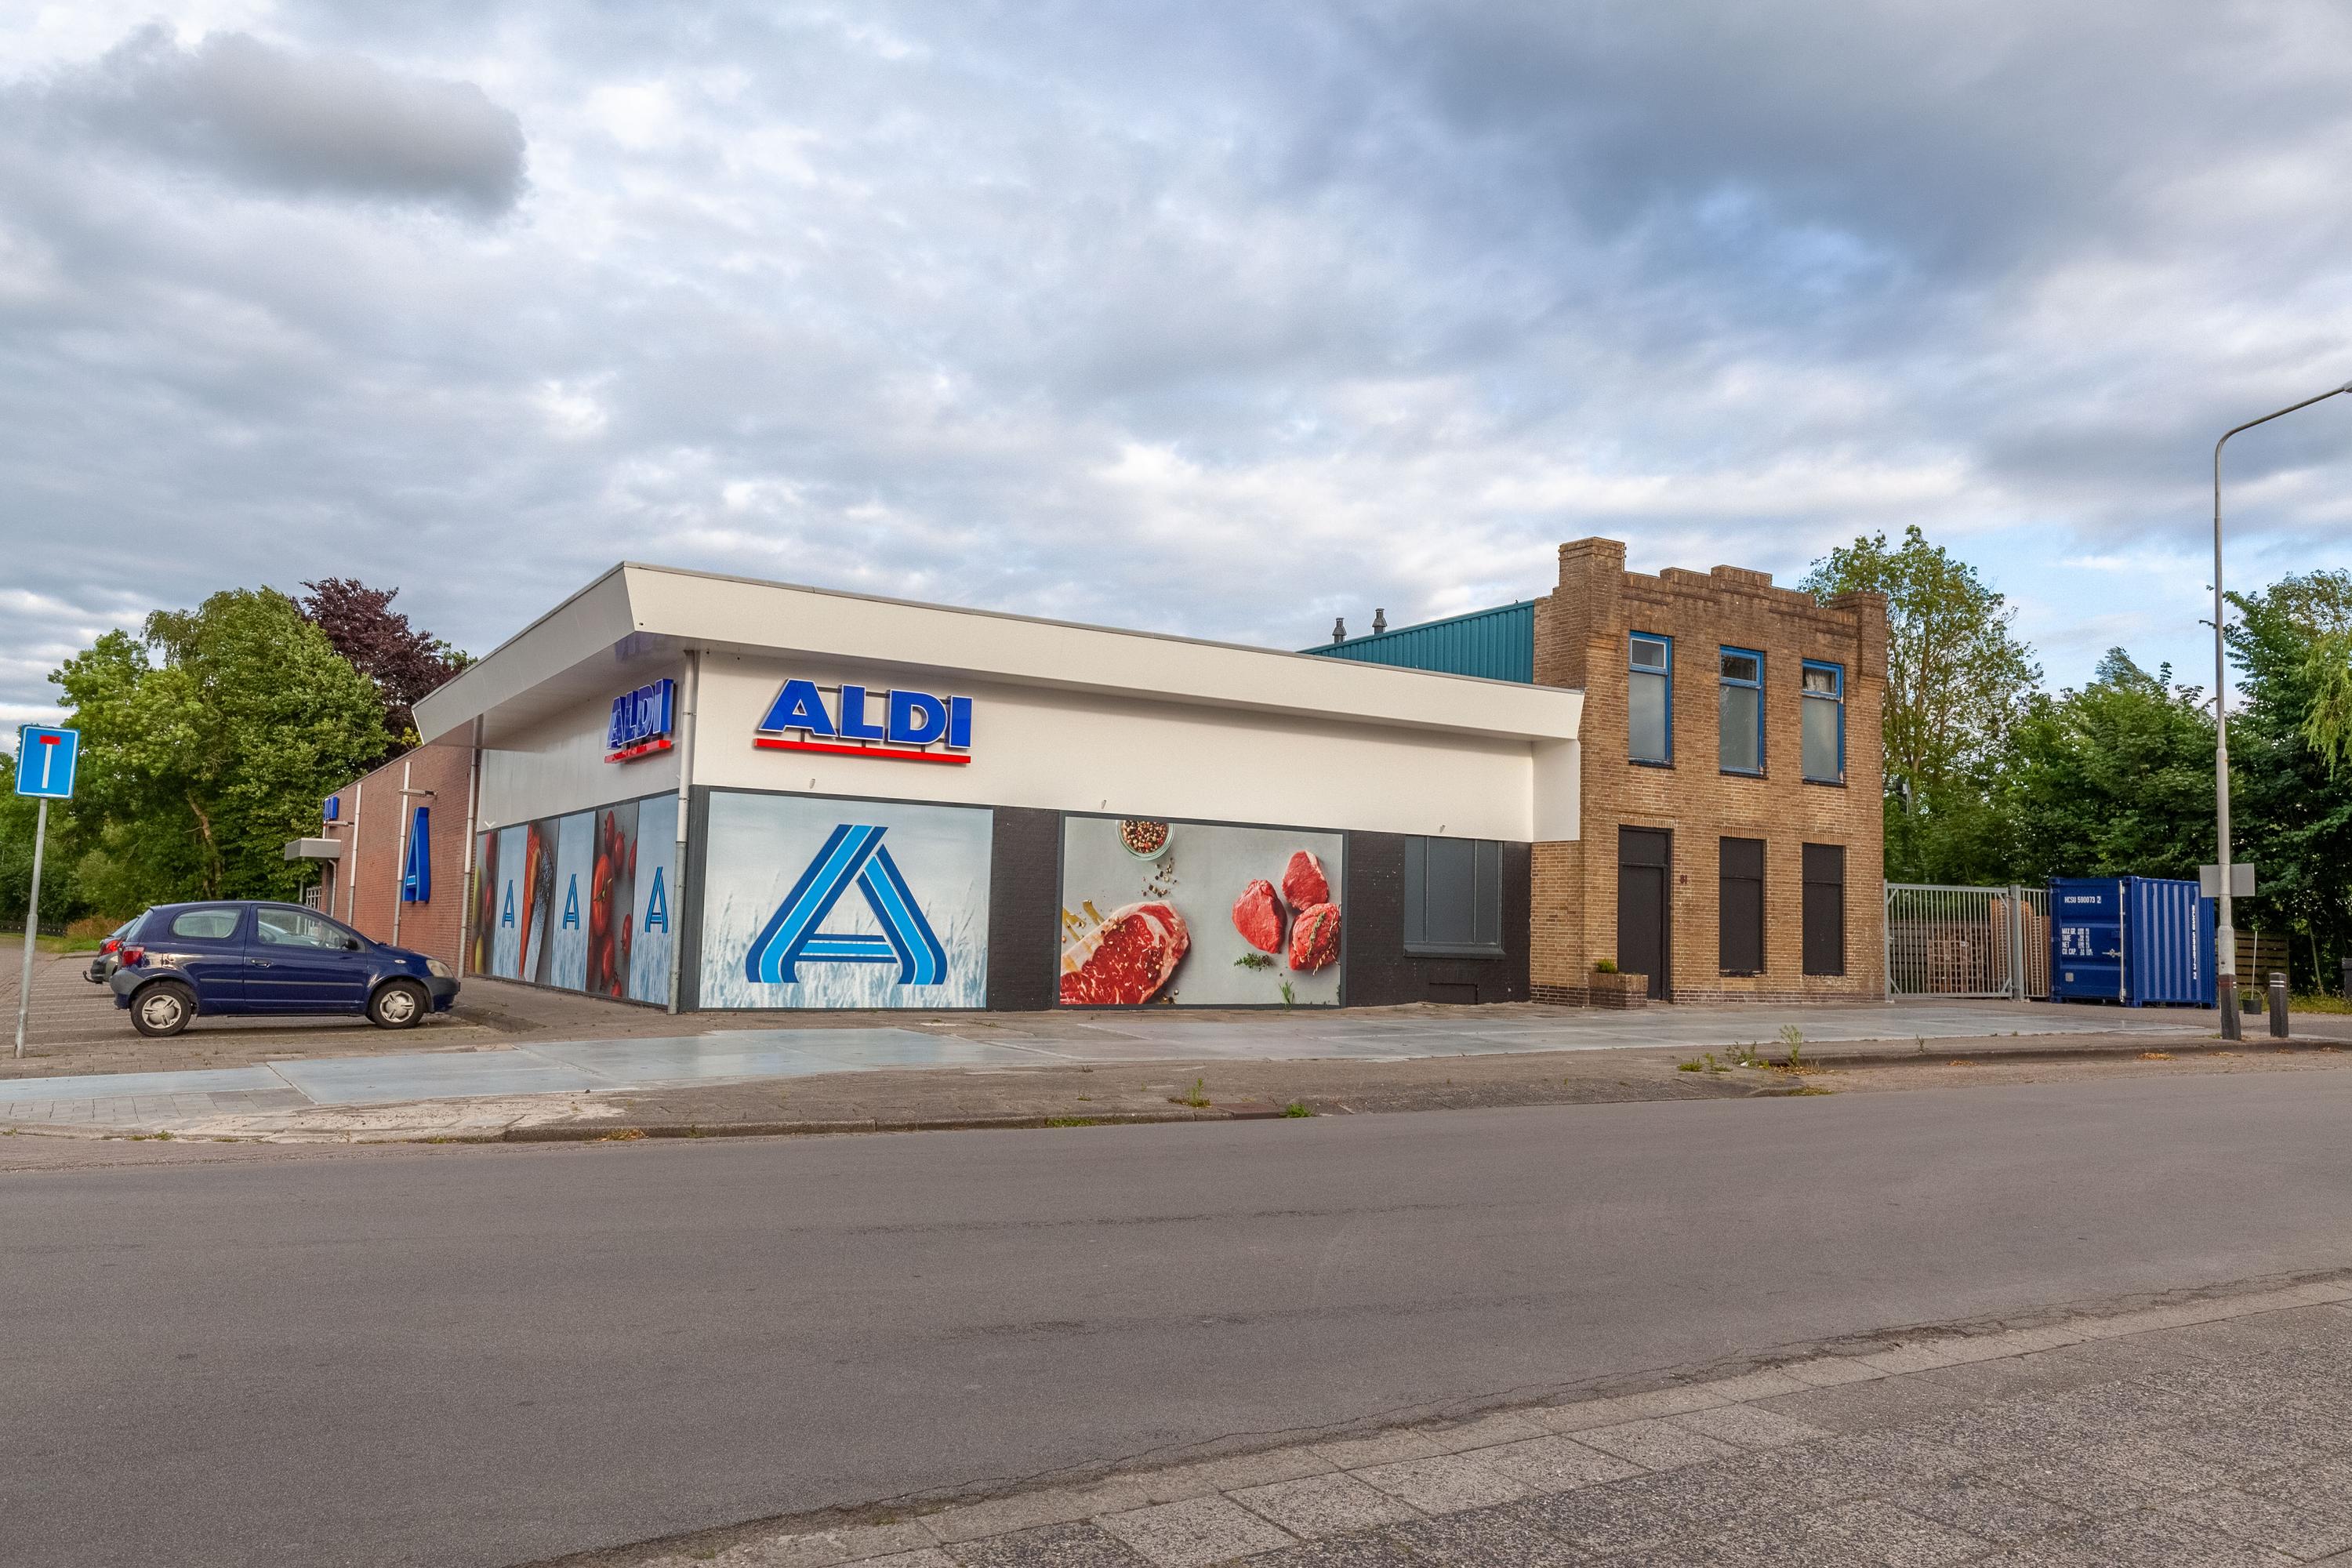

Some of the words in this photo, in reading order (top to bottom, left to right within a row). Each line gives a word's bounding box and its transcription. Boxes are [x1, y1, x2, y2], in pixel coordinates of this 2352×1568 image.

[607, 678, 673, 750] ALDI
[757, 677, 973, 749] ALDI
[502, 879, 515, 928] A
[562, 873, 579, 930] A
[644, 866, 668, 934] A
[746, 824, 948, 985] A
